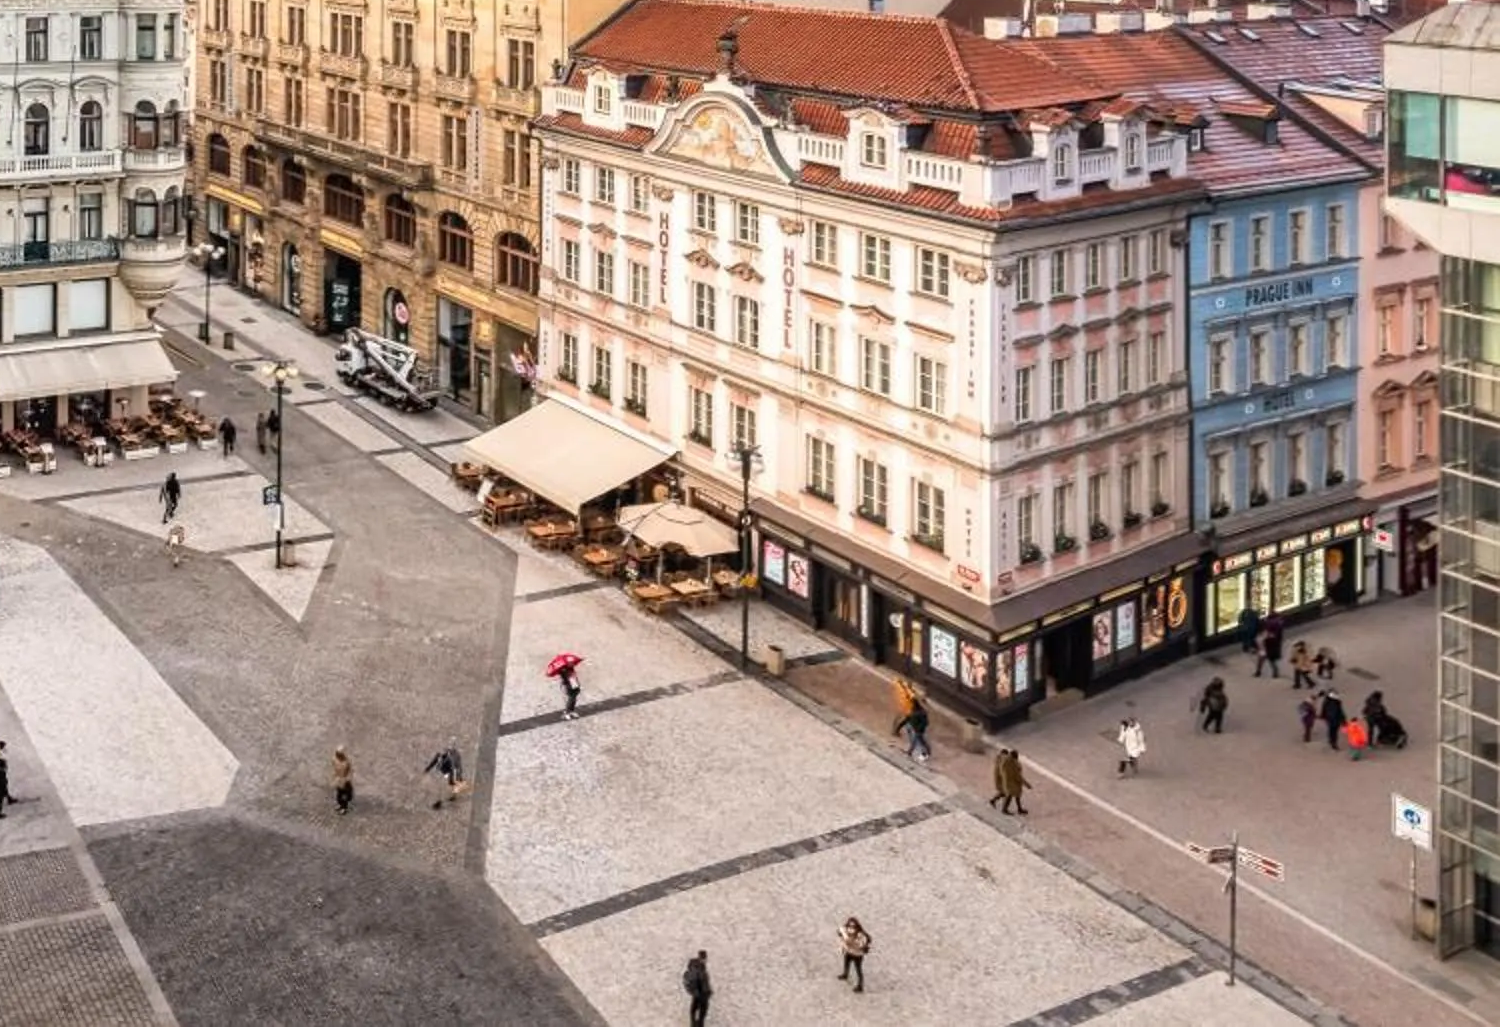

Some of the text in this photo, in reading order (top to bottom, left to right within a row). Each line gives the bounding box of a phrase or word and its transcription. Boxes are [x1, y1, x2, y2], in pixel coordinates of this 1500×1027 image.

[659, 212, 669, 304] HOTEL
[782, 247, 795, 349] HOTEL
[1245, 278, 1314, 307] PRAGUE INN
